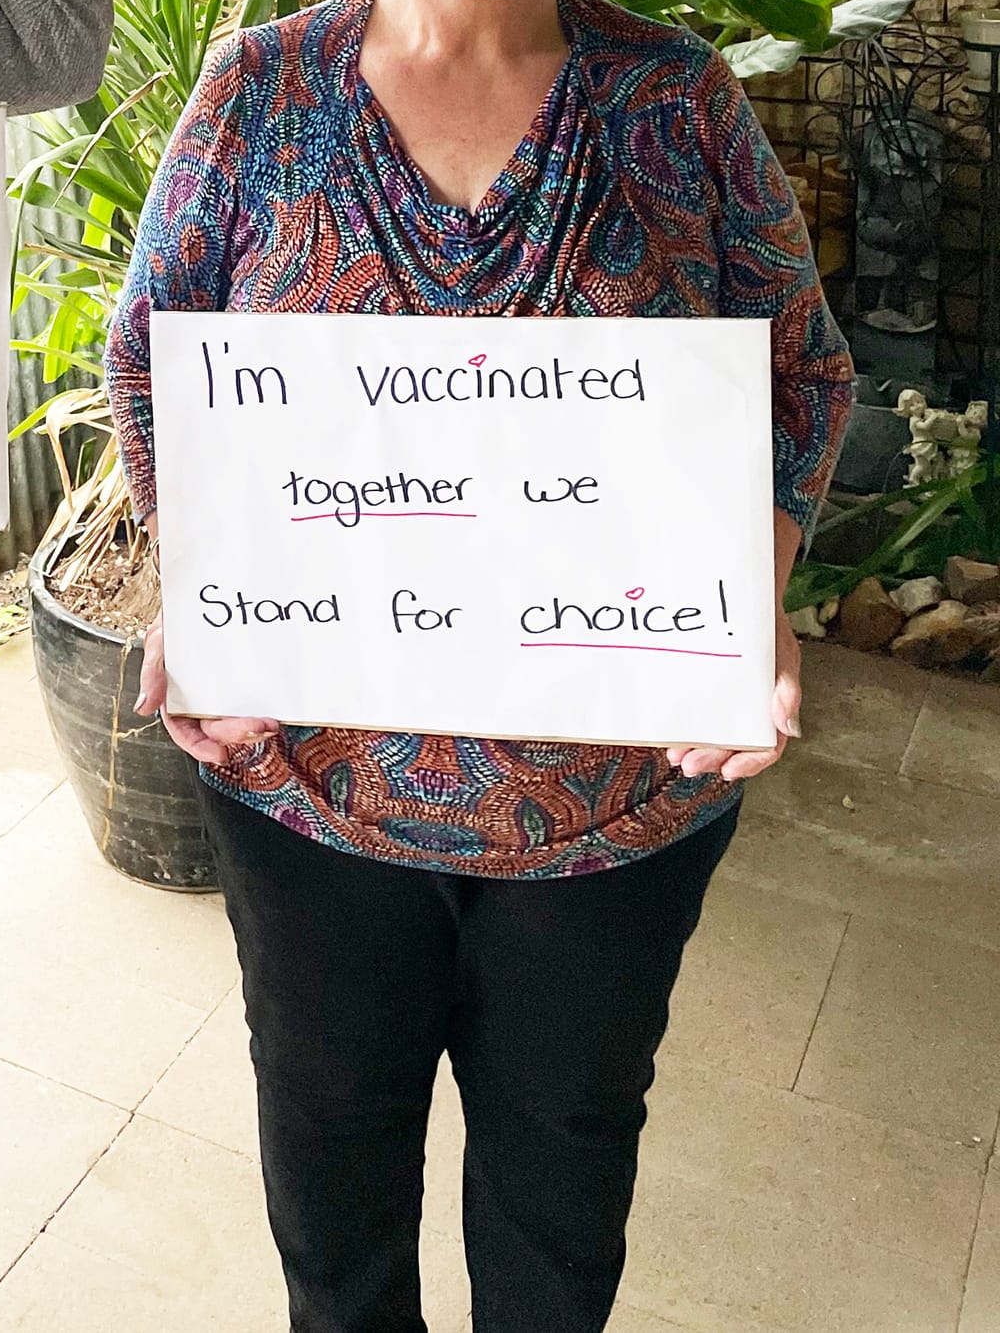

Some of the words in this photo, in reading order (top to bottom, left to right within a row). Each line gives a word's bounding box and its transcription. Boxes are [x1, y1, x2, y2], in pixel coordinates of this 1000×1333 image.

[202, 341, 288, 408] I'm
[357, 354, 647, 406] vaccinated
[281, 470, 473, 527] together
[523, 475, 600, 504] we
[199, 584, 340, 627] Stand
[391, 590, 463, 634] for
[520, 579, 735, 636] choice!
